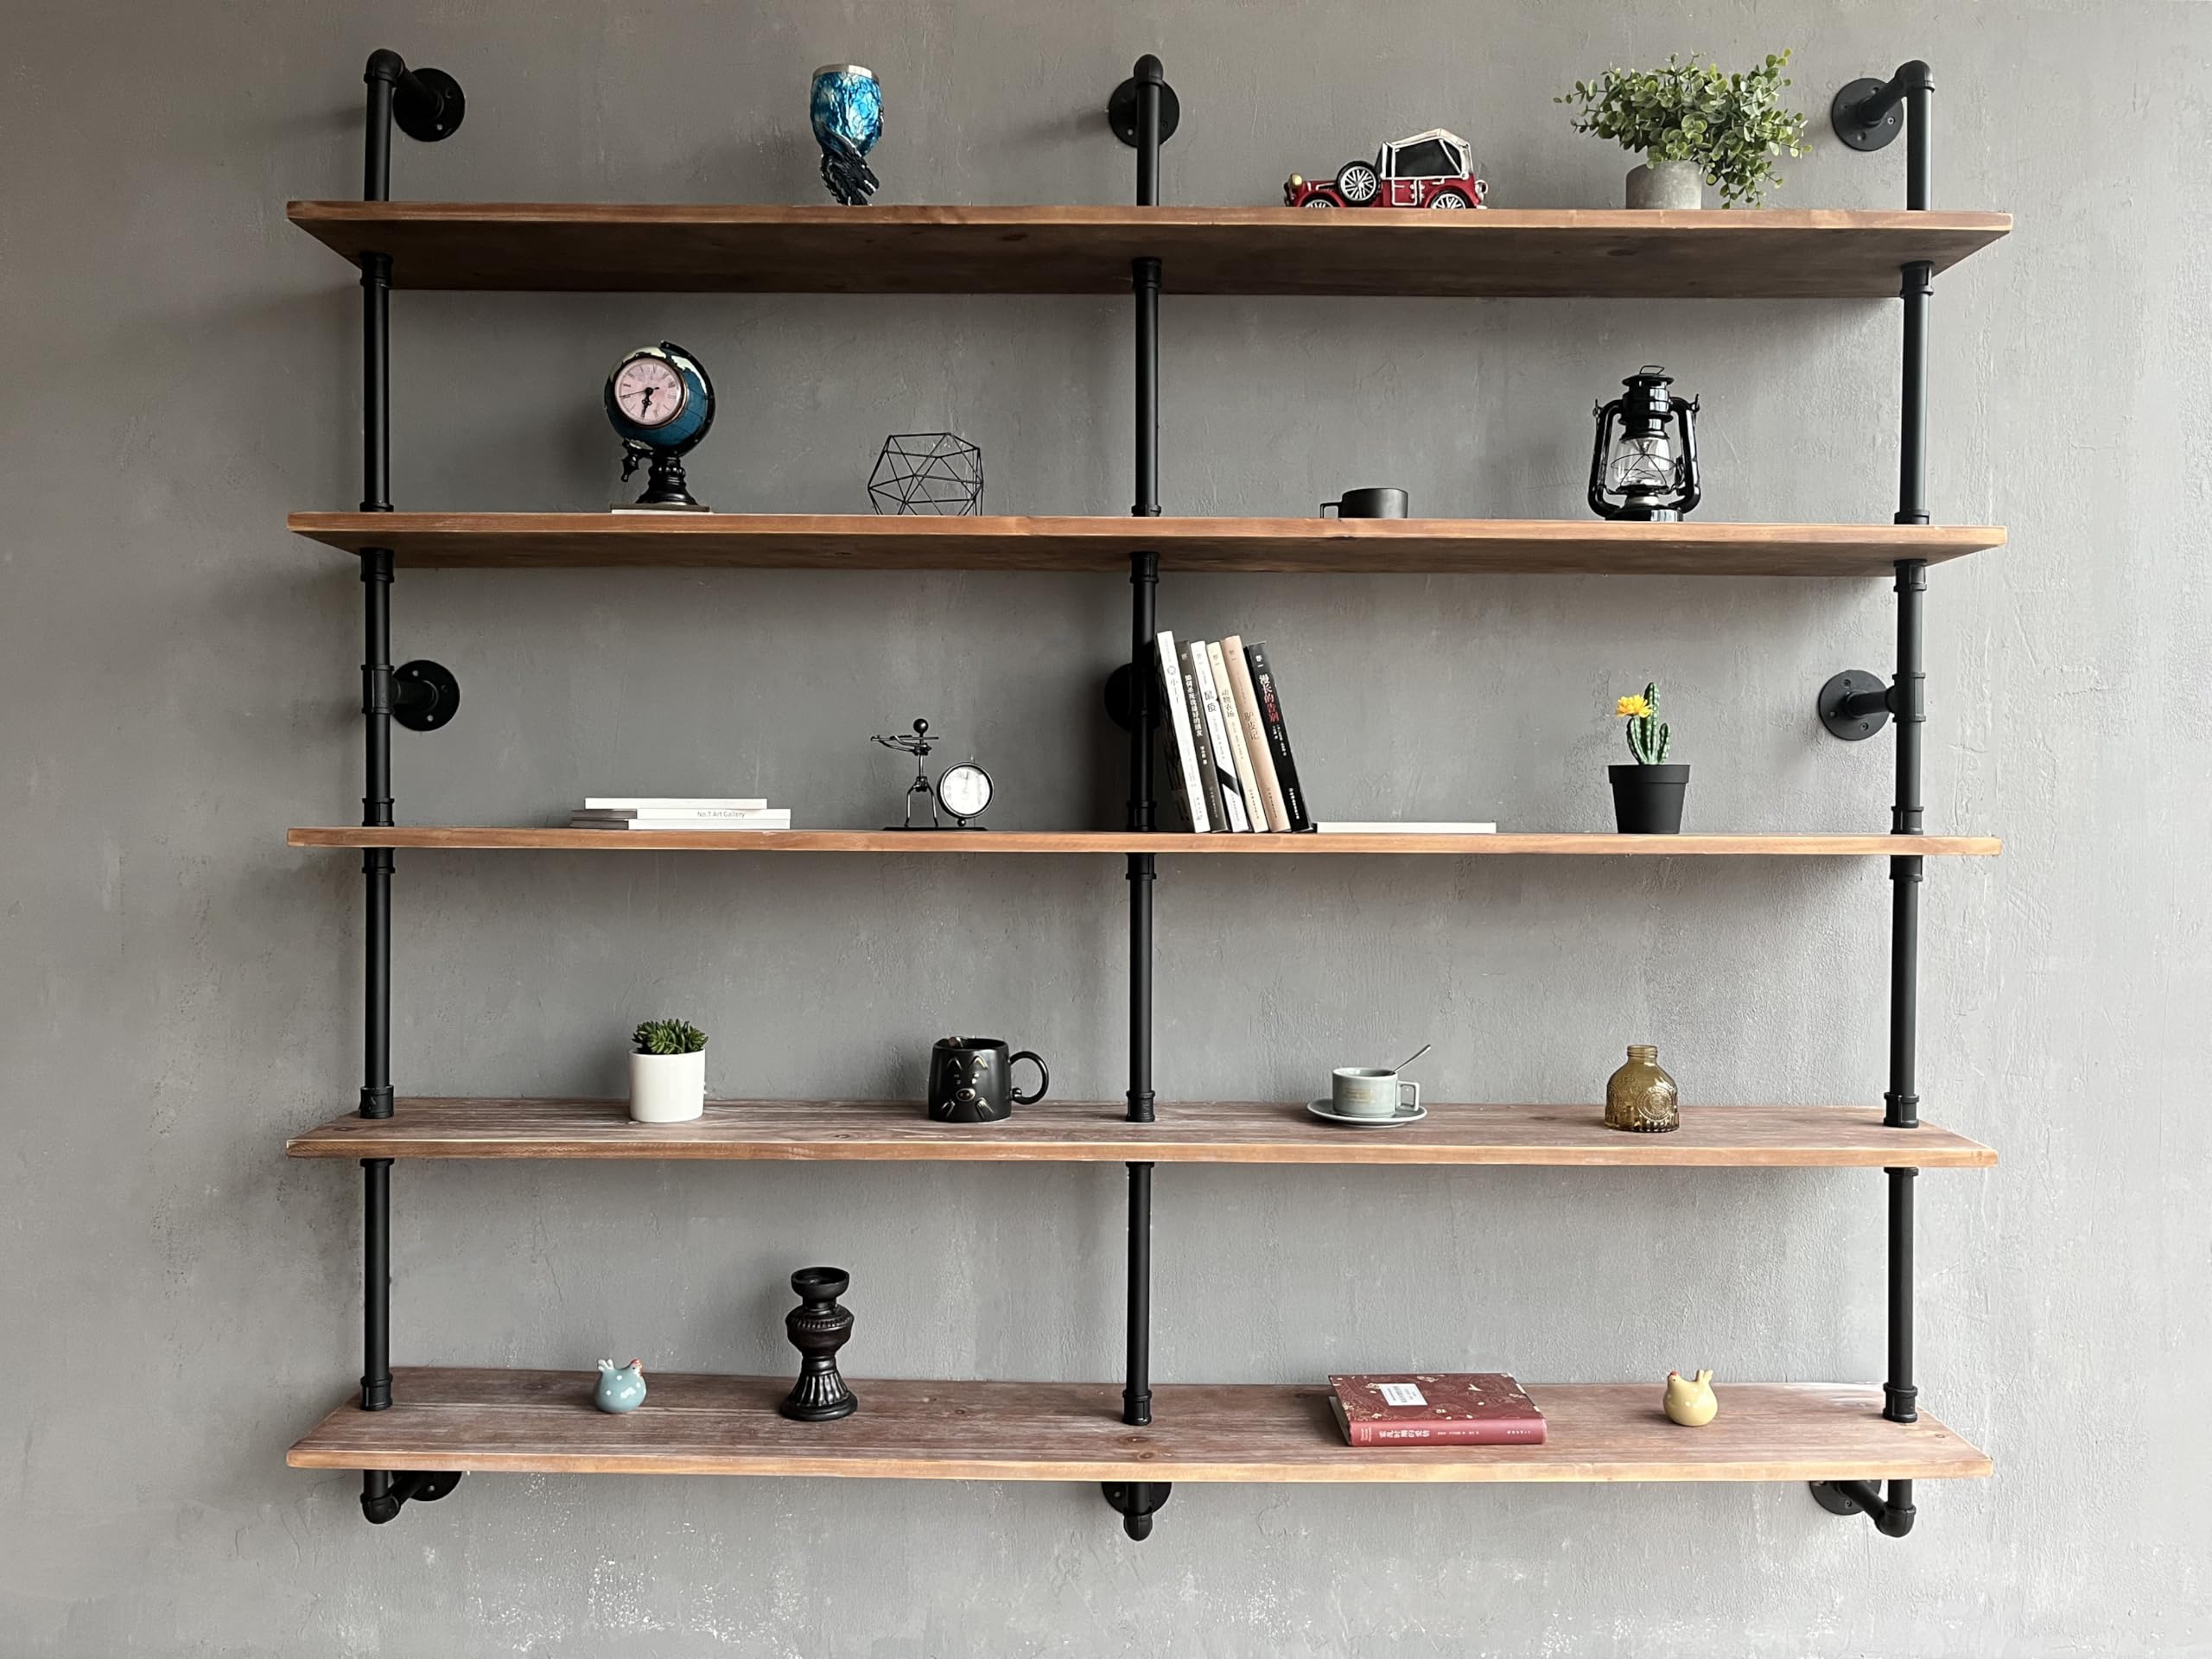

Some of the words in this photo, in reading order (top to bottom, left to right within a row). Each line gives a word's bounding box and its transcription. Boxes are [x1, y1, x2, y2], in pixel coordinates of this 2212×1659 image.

[1205, 690, 1217, 713] 鼠疫
[1222, 689, 1235, 718] 动物农场
[1258, 674, 1280, 722] 漫长的告别
[1244, 711, 1260, 740] 驴皮记
[1379, 1429, 1431, 1439] 霍乱时期的爱情
